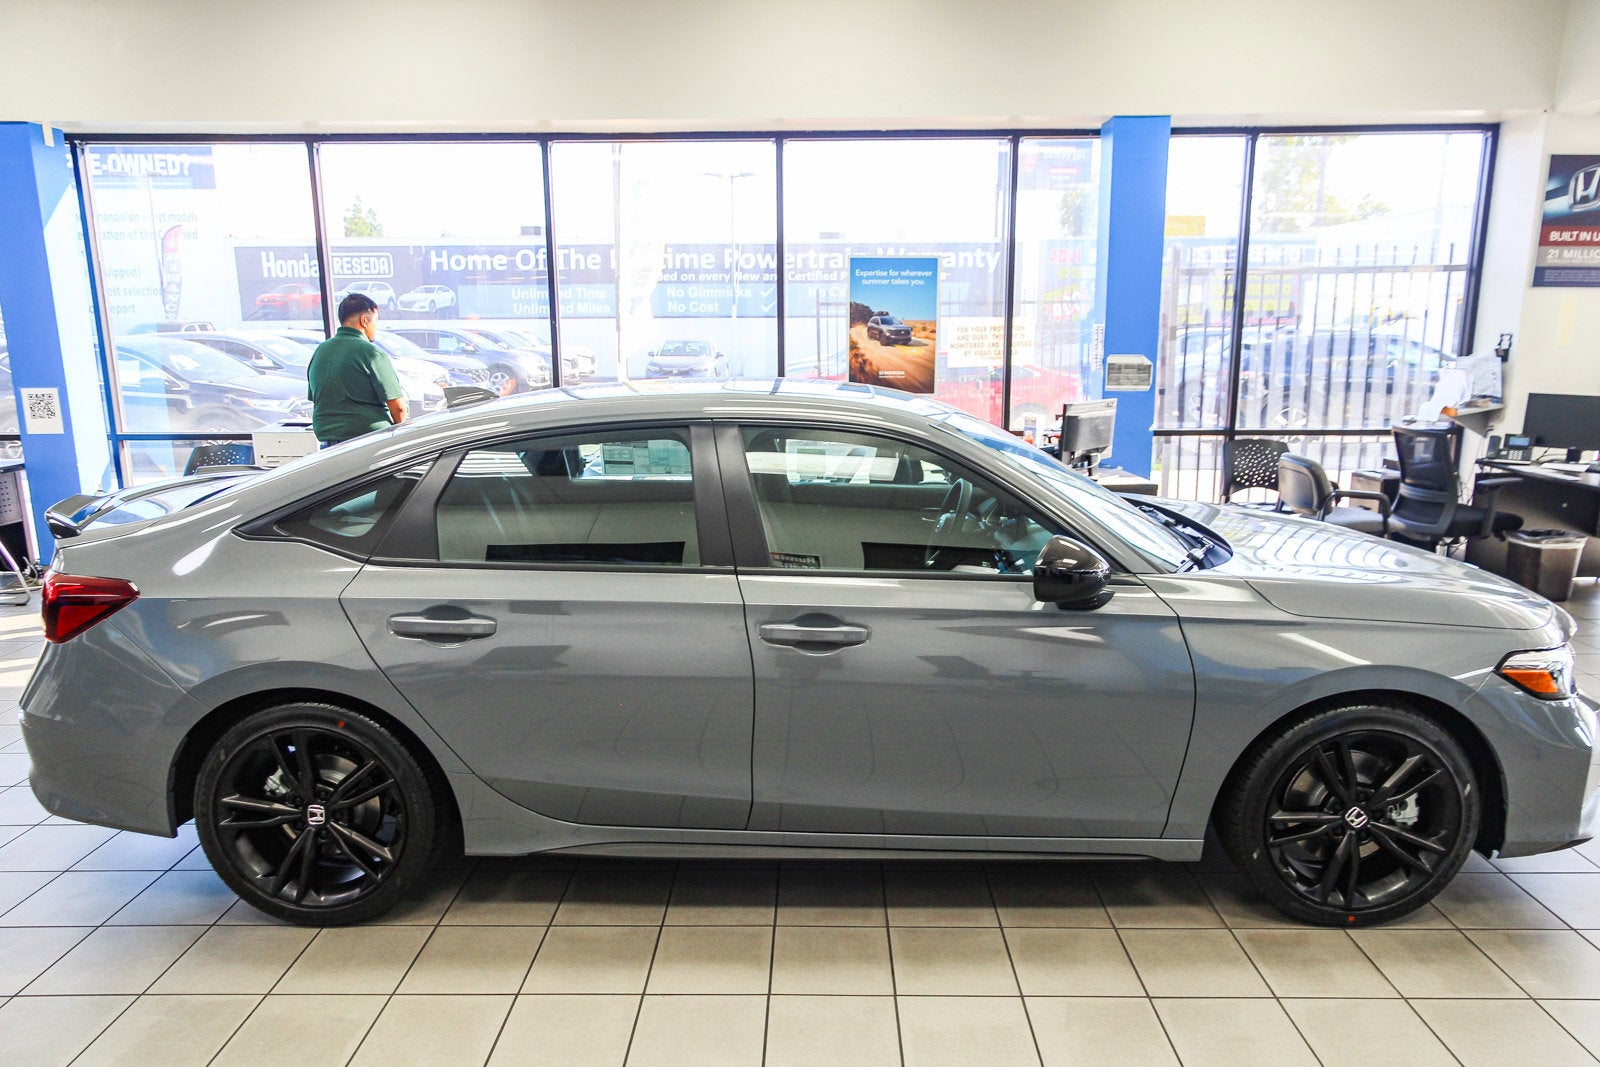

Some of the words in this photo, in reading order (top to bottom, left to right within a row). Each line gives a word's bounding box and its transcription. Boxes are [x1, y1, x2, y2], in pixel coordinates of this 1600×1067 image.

[1549, 230, 1578, 242] BUILT
[1579, 230, 1592, 242] IN
[430, 250, 508, 271] Home
[516, 249, 547, 270] Of
[557, 249, 602, 270] The
[1547, 248, 1560, 259] 21
[261, 252, 319, 278] Honda
[333, 256, 389, 275] RESEDA
[681, 273, 695, 281] on
[698, 273, 730, 283] every
[787, 270, 836, 281] Certified
[855, 269, 888, 279] Expertise
[889, 269, 899, 278] for
[901, 269, 932, 277] wherever
[910, 280, 925, 289] you.
[575, 286, 607, 299] Time
[666, 286, 682, 298] No
[576, 301, 611, 315] Miles
[668, 301, 683, 313] No
[688, 300, 719, 313] Cost
